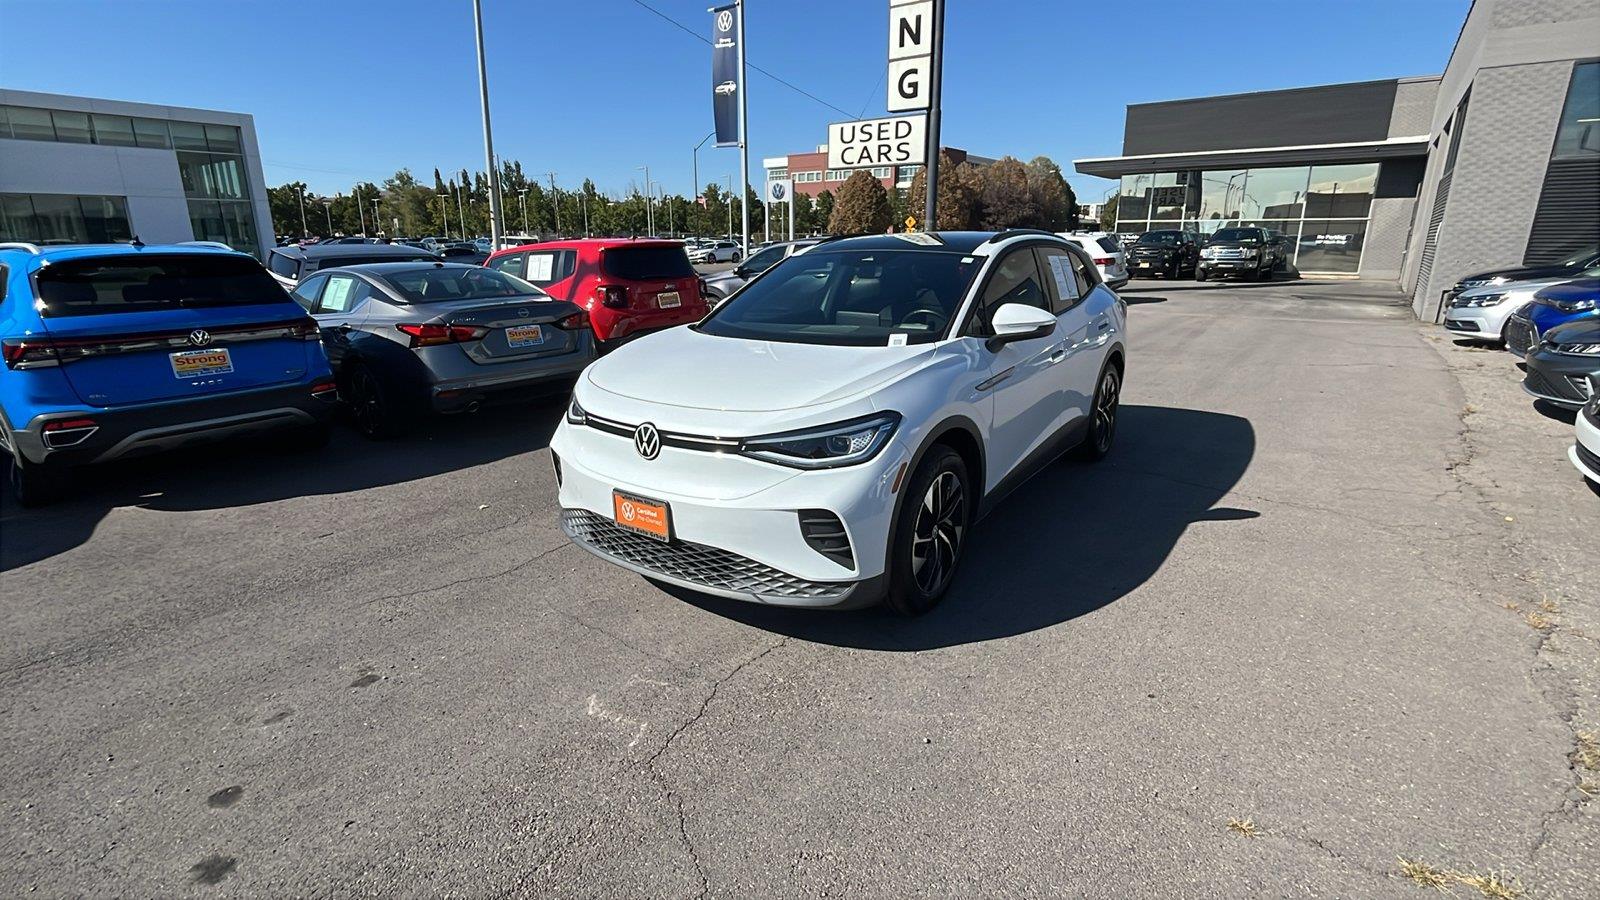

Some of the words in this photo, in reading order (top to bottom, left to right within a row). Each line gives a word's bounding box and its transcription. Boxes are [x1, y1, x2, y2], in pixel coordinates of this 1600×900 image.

[840, 120, 912, 144] USED
[840, 142, 910, 165] CARS
[175, 355, 226, 366] Strong
